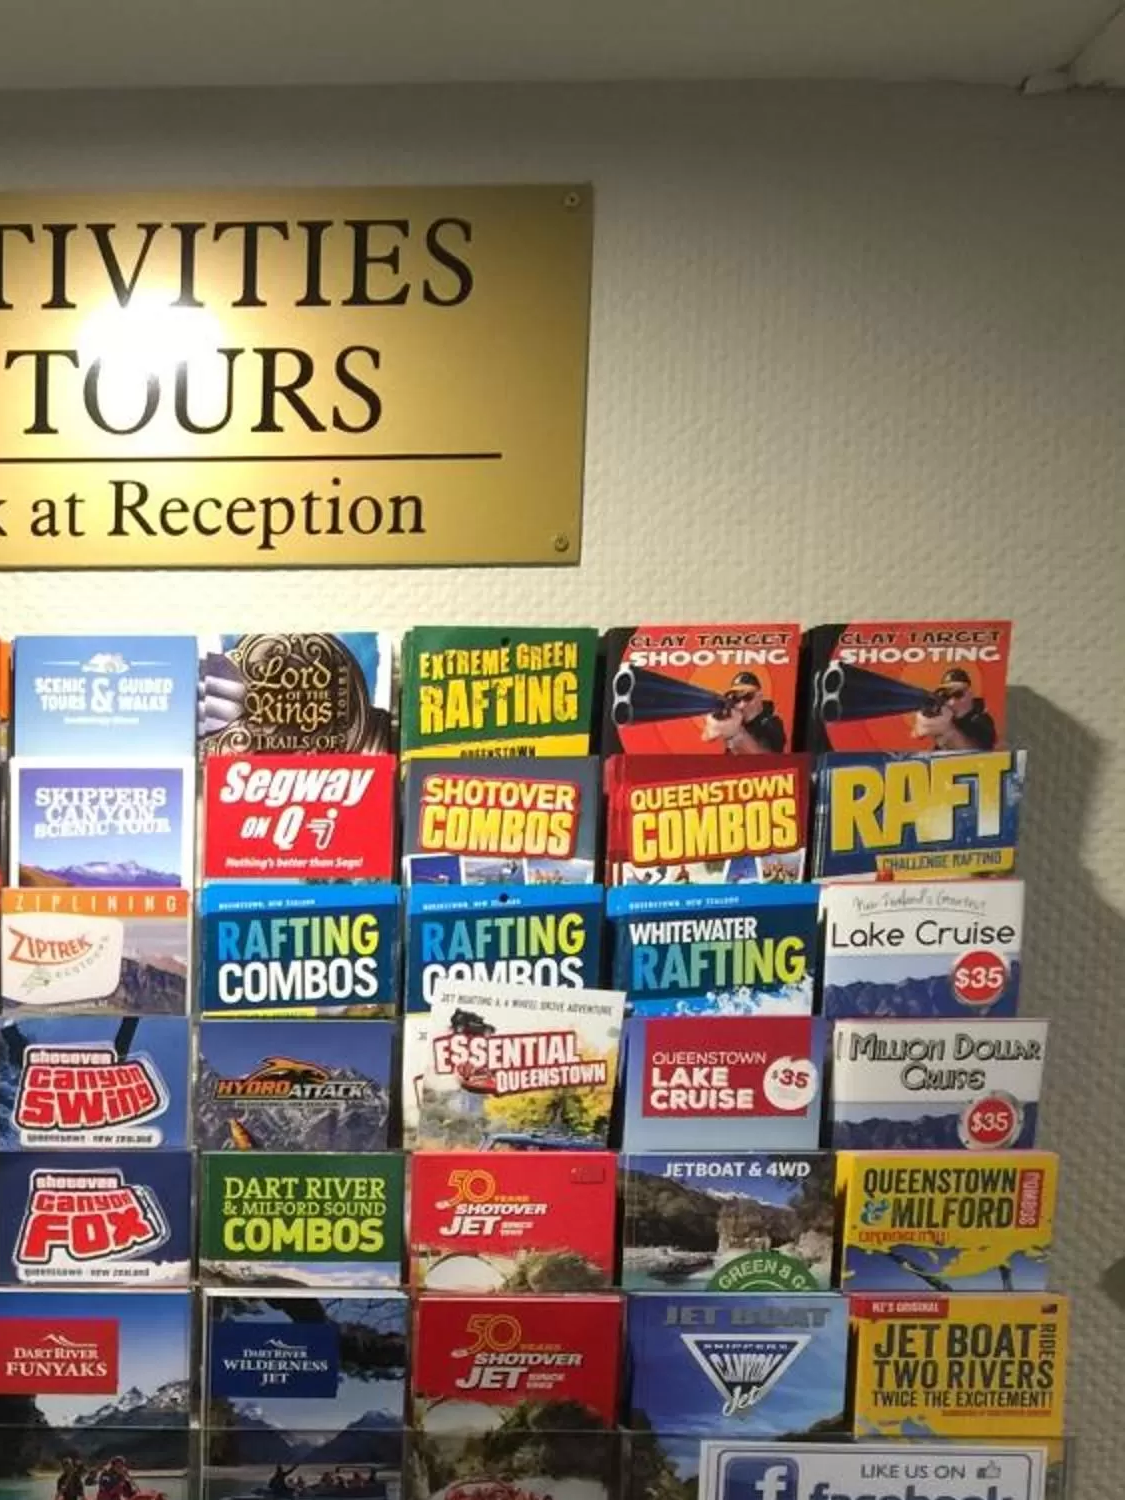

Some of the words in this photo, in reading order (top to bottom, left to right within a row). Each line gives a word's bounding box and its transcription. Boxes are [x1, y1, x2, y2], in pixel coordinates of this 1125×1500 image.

[5, 345, 381, 436] TOURS
[31, 490, 84, 536] at
[108, 476, 426, 550] Reception
[248, 657, 331, 690] Lord
[419, 646, 509, 678] EXTREME
[516, 642, 577, 669] GREEN
[628, 650, 790, 667] SHOOTING
[247, 694, 332, 731] Rings
[419, 672, 578, 734] RAFTING
[36, 788, 166, 806] SKIPPERS
[221, 763, 374, 804] Segway
[426, 778, 575, 810] SHOTOVER
[631, 774, 794, 811] QUEENSTOWN
[46, 804, 156, 822] CANYON
[831, 753, 1012, 853] RAFT
[241, 816, 271, 838] ON
[273, 807, 303, 850] Q
[421, 806, 573, 855] COMBOS
[632, 799, 797, 862] COMBOS
[217, 914, 378, 961] RAFTING
[629, 917, 757, 944] WHITEWATER
[832, 922, 903, 947] Lake
[917, 920, 1015, 945] Cruise
[633, 936, 806, 989] RAFTING
[218, 959, 378, 1003] COMBOS
[954, 967, 1003, 990] $35
[435, 1032, 579, 1073] ESSENTIAL
[652, 1052, 766, 1065] QUEENSTOWN
[496, 1064, 606, 1092] QUEENSTOWN
[652, 1067, 728, 1088] LAKE
[651, 1089, 753, 1110] CRUISE
[663, 1163, 746, 1178] JETBOAT
[749, 1163, 762, 1177] &
[767, 1162, 810, 1177] 4WD
[864, 1169, 1016, 1197] QUEENSTOWN
[225, 1177, 298, 1198] DART
[306, 1177, 385, 1199] RIVER
[223, 1201, 238, 1216] &
[242, 1201, 319, 1216] MILFORD
[323, 1201, 386, 1216] SOUND
[455, 1204, 547, 1216] SHOTOVER
[892, 1198, 1014, 1228] MILFORD
[224, 1218, 383, 1253] COMBOS
[440, 1216, 500, 1236] JET
[875, 1324, 940, 1359] JET
[947, 1323, 1035, 1359] BOAT
[6, 1362, 107, 1377] FUNYAKS
[223, 1359, 328, 1372] WILDERNESS
[874, 1360, 937, 1390] TWO
[947, 1360, 1053, 1389] RIVERS
[861, 1464, 900, 1479] LIKE
[905, 1465, 929, 1479] US
[935, 1465, 965, 1479] ON
